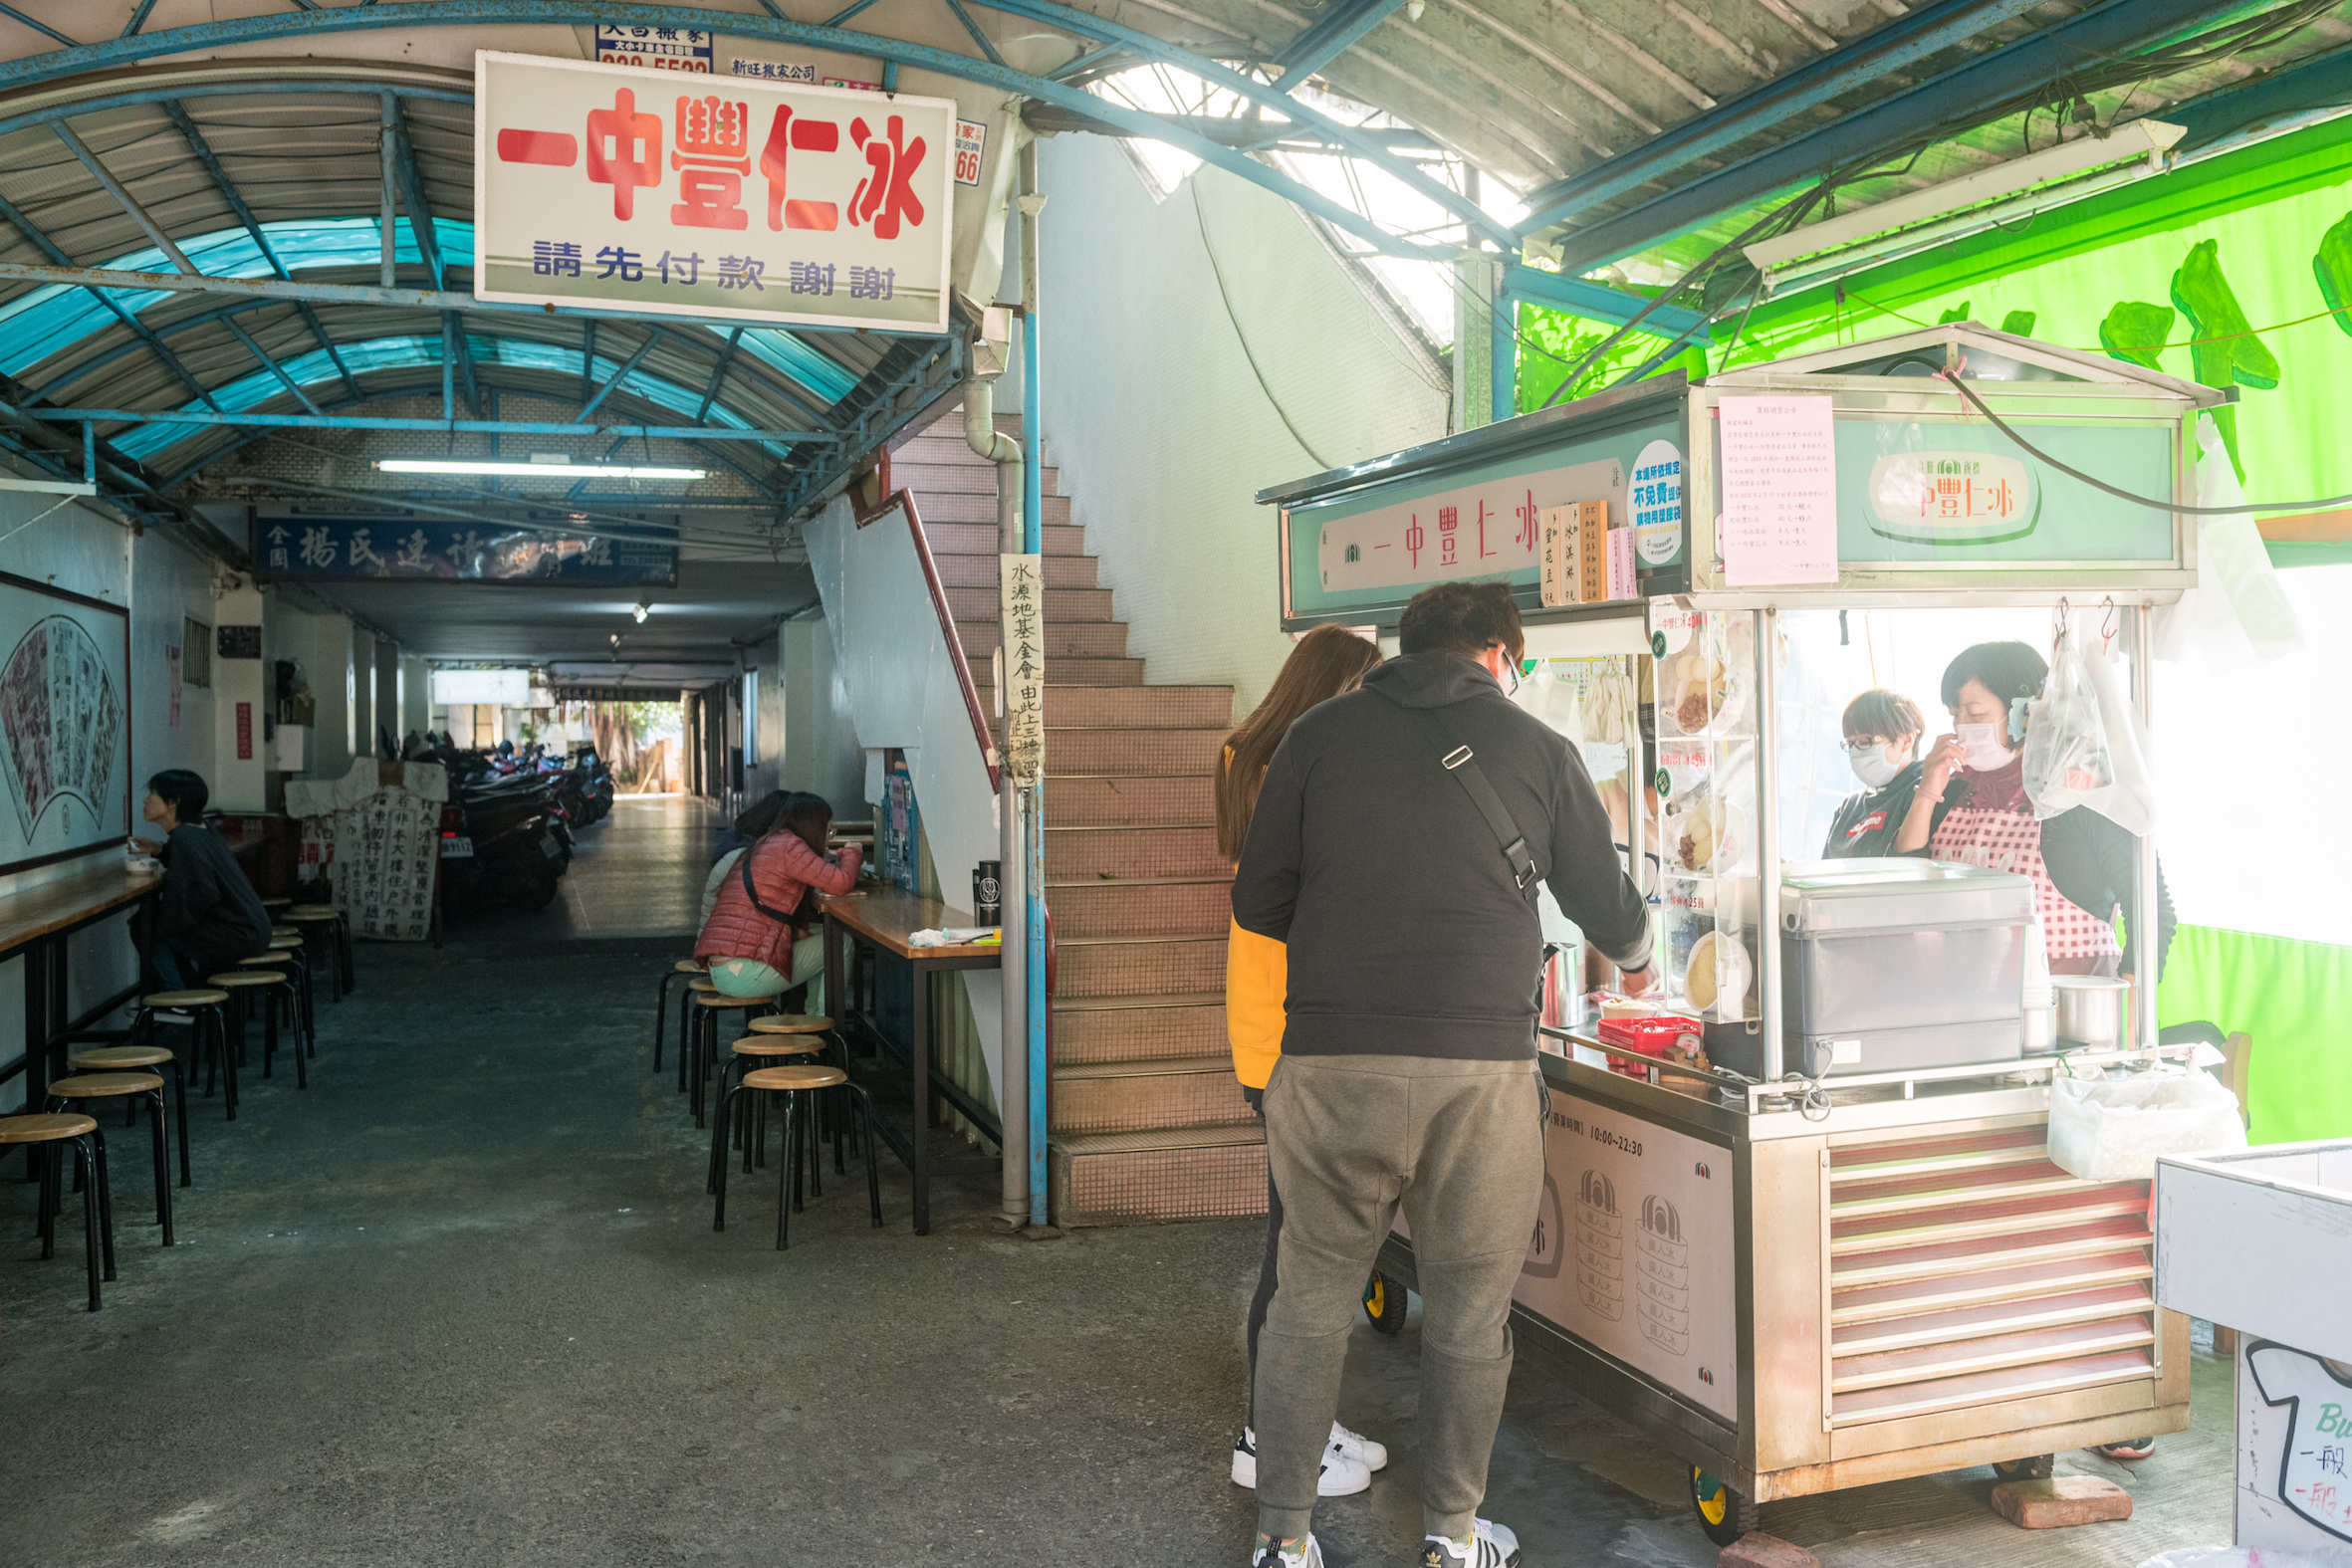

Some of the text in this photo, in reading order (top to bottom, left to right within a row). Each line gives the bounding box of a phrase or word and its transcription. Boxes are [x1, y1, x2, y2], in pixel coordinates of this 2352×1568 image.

[731, 60, 816, 82] 新旺搬家公司
[497, 87, 926, 240] 一中豐仁冰
[956, 150, 979, 181] 66
[1756, 406, 1797, 415] 價格調整公告
[1635, 461, 1680, 483] 本場所依規定
[1910, 477, 2013, 518] 中豐仁冰
[1374, 489, 1539, 570] 一中豐仁冰
[1590, 1125, 1643, 1157] 10:00~22:30
